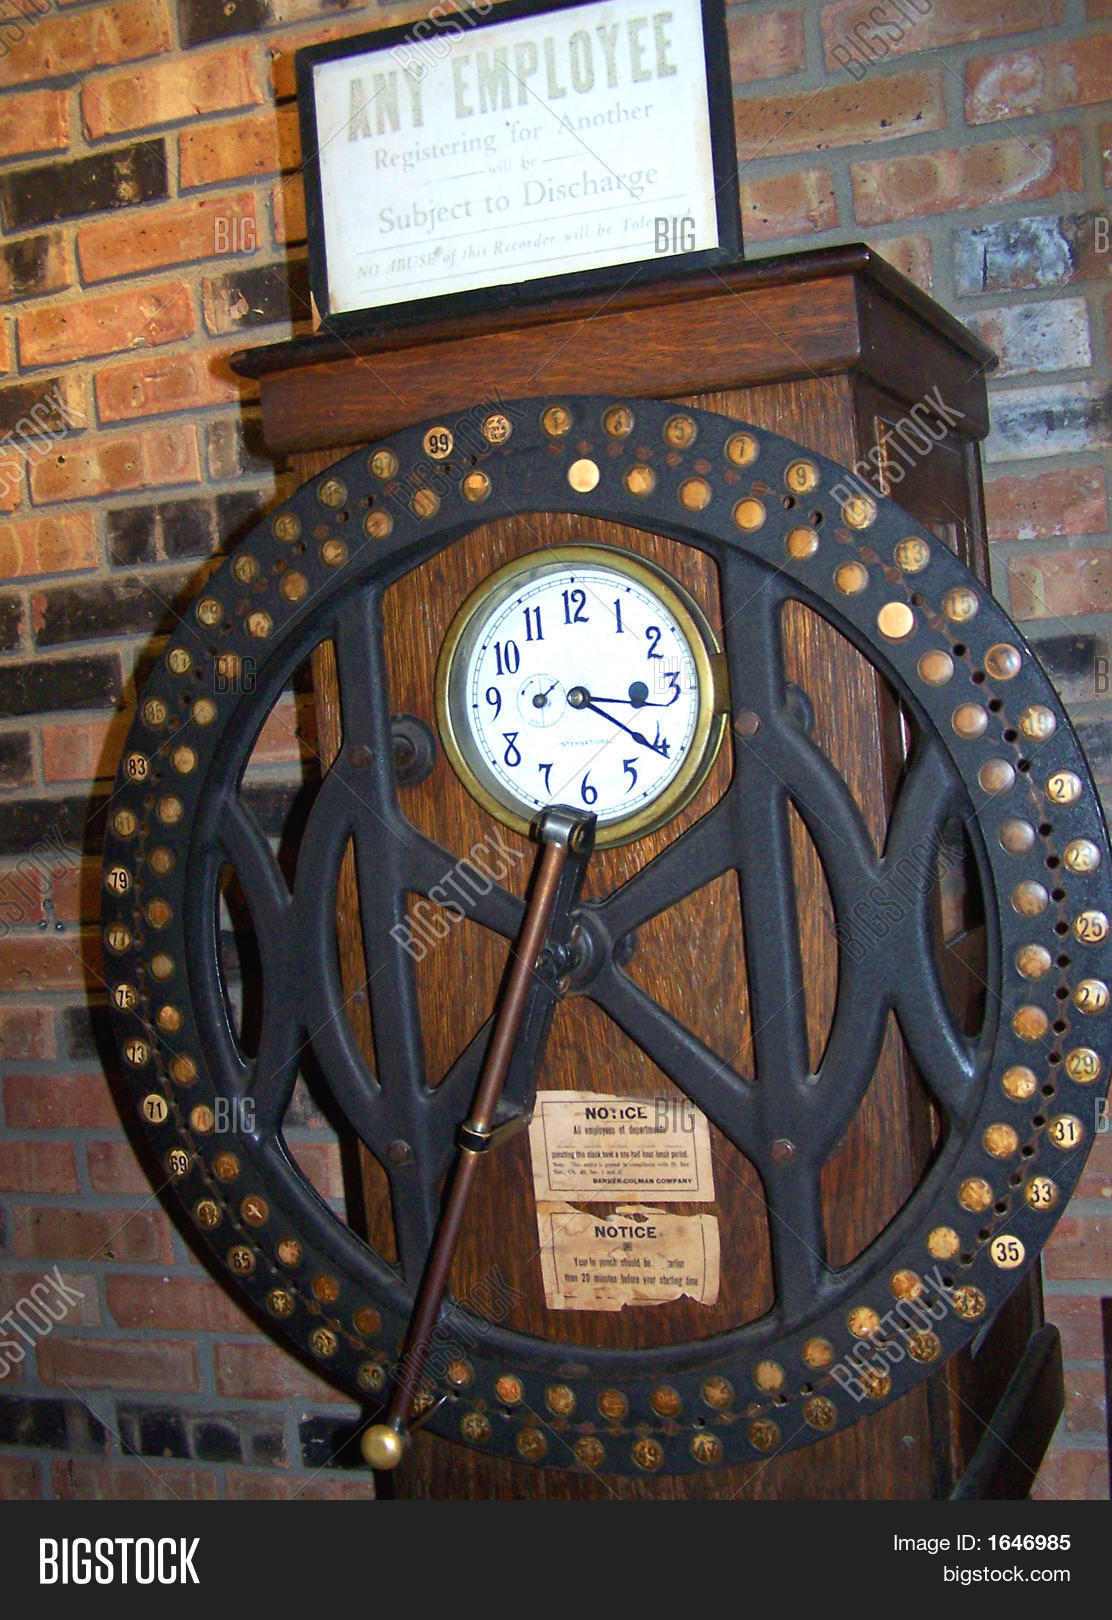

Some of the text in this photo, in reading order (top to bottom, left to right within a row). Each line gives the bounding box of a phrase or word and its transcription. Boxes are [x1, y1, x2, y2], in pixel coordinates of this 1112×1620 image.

[348, 11, 679, 143] ANY EMPLOYEE
[374, 101, 654, 173] Registering for Another
[379, 167, 658, 235] Subject to Discharge
[356, 262, 380, 280] NO
[386, 251, 437, 275] ABUSE
[442, 248, 457, 267] of
[461, 245, 487, 261] this
[564, 224, 590, 242] will
[597, 223, 613, 237] be
[674, 420, 686, 441] 5
[429, 433, 449, 454] 99
[735, 439, 747, 459] 7
[795, 466, 808, 487] 9
[902, 544, 925, 565] 13
[561, 589, 590, 625] 12
[614, 598, 625, 634] 1
[523, 606, 545, 642] 11
[645, 625, 664, 660] 2
[493, 639, 520, 676] 10
[663, 671, 682, 707] 3
[485, 686, 502, 722] 9
[652, 720, 671, 754] 4
[502, 732, 521, 767] 8
[128, 758, 146, 776] 83
[623, 757, 639, 793] 5
[538, 763, 554, 796] 7
[580, 770, 598, 805] 6
[111, 871, 129, 890] 79
[1079, 916, 1102, 938] 25
[1071, 1053, 1094, 1075] 29
[146, 1101, 163, 1119] 71
[1055, 1121, 1076, 1142] 31
[170, 1154, 187, 1173] 69
[1031, 1183, 1053, 1204] 33
[594, 1226, 657, 1239] NOTICE
[233, 1251, 250, 1270] 65
[996, 1242, 1020, 1263] 35
[581, 1273, 591, 1283] 20
